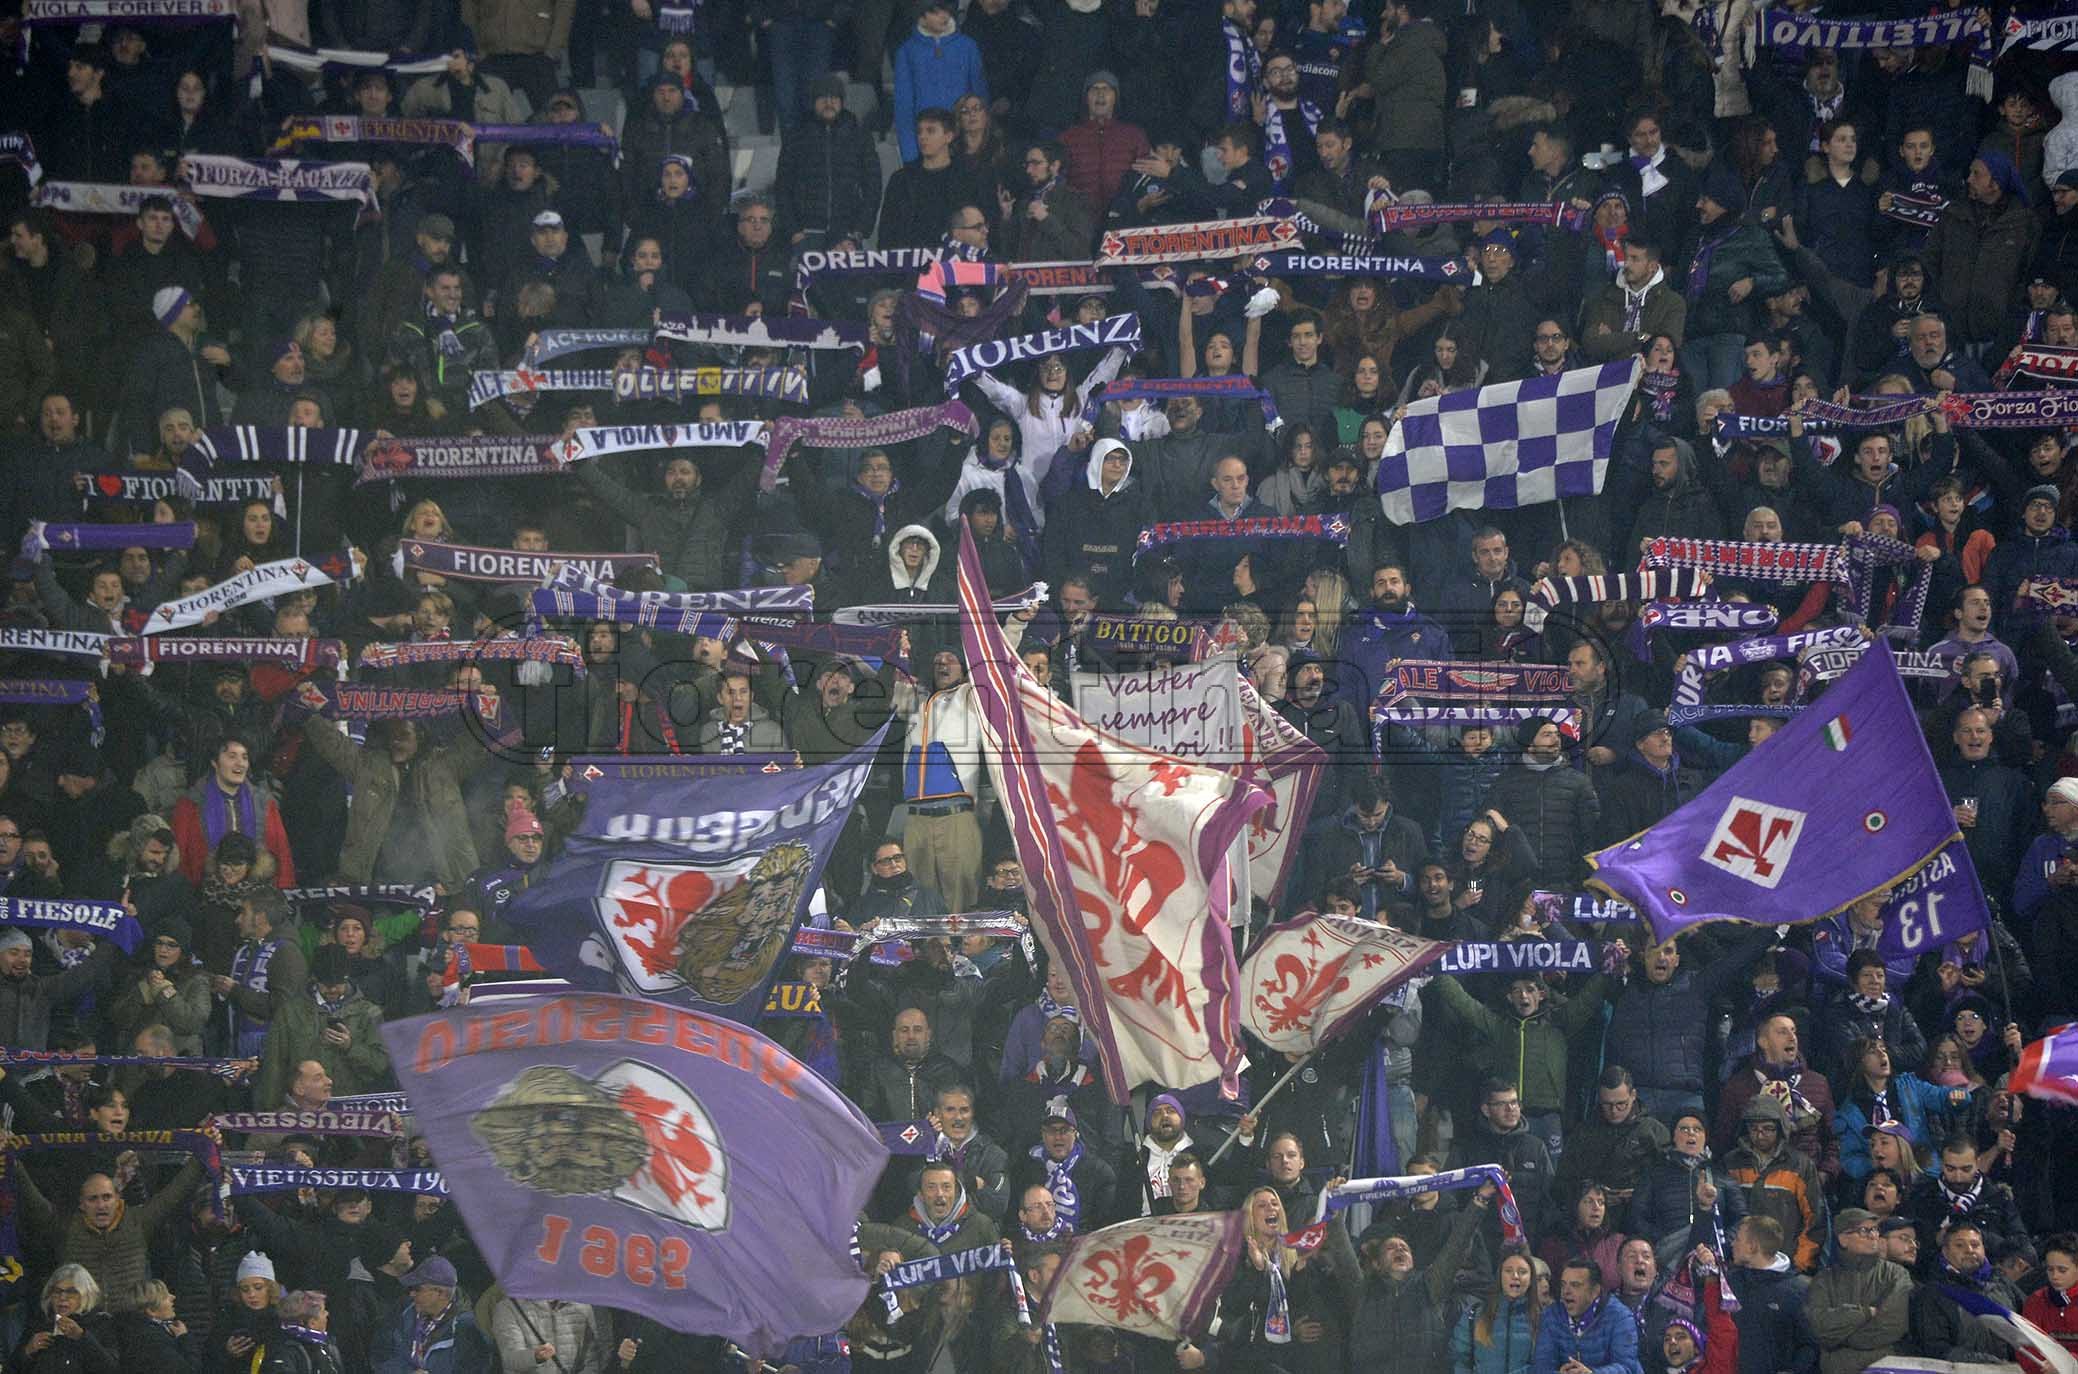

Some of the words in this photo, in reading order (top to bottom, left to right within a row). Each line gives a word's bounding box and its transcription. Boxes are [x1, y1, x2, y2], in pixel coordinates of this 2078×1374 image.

[29, 1, 89, 18] VIOLA
[106, 0, 205, 17] FOREVER
[2026, 16, 2078, 41] FIO
[1125, 224, 1273, 257] FIORENTINA
[1287, 255, 1426, 274] FIORENTINA
[1973, 399, 2036, 419] Forza
[589, 424, 661, 451] VIOLA
[699, 421, 752, 443] AMO
[415, 446, 540, 467] FIORENTINA
[453, 551, 616, 581] FIORENNA
[1650, 538, 1829, 570] FIORENTINA
[178, 564, 292, 614] FIORENTINA
[0, 629, 105, 653] RENTINA
[159, 643, 299, 659] FIORENTINA
[1102, 670, 1207, 698] Valter
[1523, 671, 1578, 693] VIOL
[1100, 702, 1217, 735] sempre
[618, 764, 749, 779] FIORENTINA
[17, 898, 125, 931] FIESOLE
[1440, 944, 1499, 972] LUPI
[1507, 942, 1593, 969] VIOLA
[217, 1111, 393, 1135] VIEUSSEUX
[232, 1168, 402, 1189] VIEUSSEUX
[883, 1258, 943, 1288] LUPI
